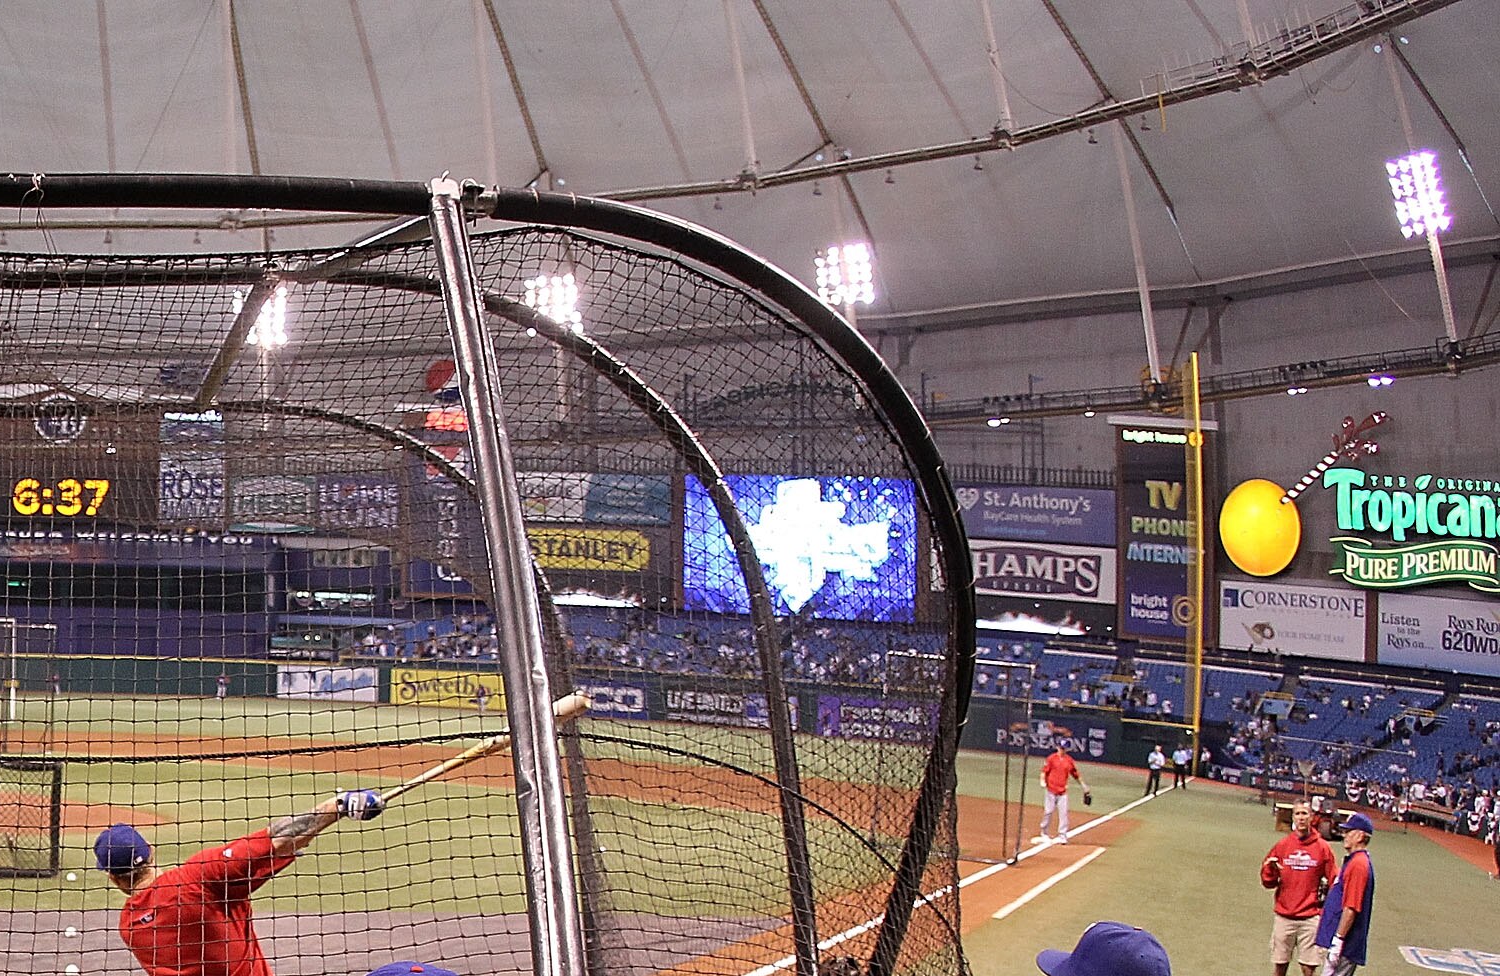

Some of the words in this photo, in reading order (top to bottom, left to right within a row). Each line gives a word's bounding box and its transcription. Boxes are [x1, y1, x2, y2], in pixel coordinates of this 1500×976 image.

[1145, 479, 1182, 511] TV
[1370, 475, 1407, 488] THE
[1436, 477, 1500, 493] ORIGINA
[12, 478, 111, 516] 6:37
[983, 490, 1006, 507] St.
[1008, 491, 1092, 516] Anthony's
[1131, 516, 1197, 538] PHONE
[207, 534, 253, 545] YOU
[528, 537, 640, 561] STANLEY
[1126, 541, 1197, 565] INTERNE
[1344, 550, 1399, 580] PURE
[1401, 548, 1497, 579] PREMIUM
[970, 550, 1100, 594] HAMPS
[1131, 592, 1169, 609] bright
[1240, 589, 1365, 618] CORNERSTONE
[1131, 606, 1169, 621] house
[1380, 612, 1421, 627] Listen
[1441, 630, 1500, 655] 620WD
